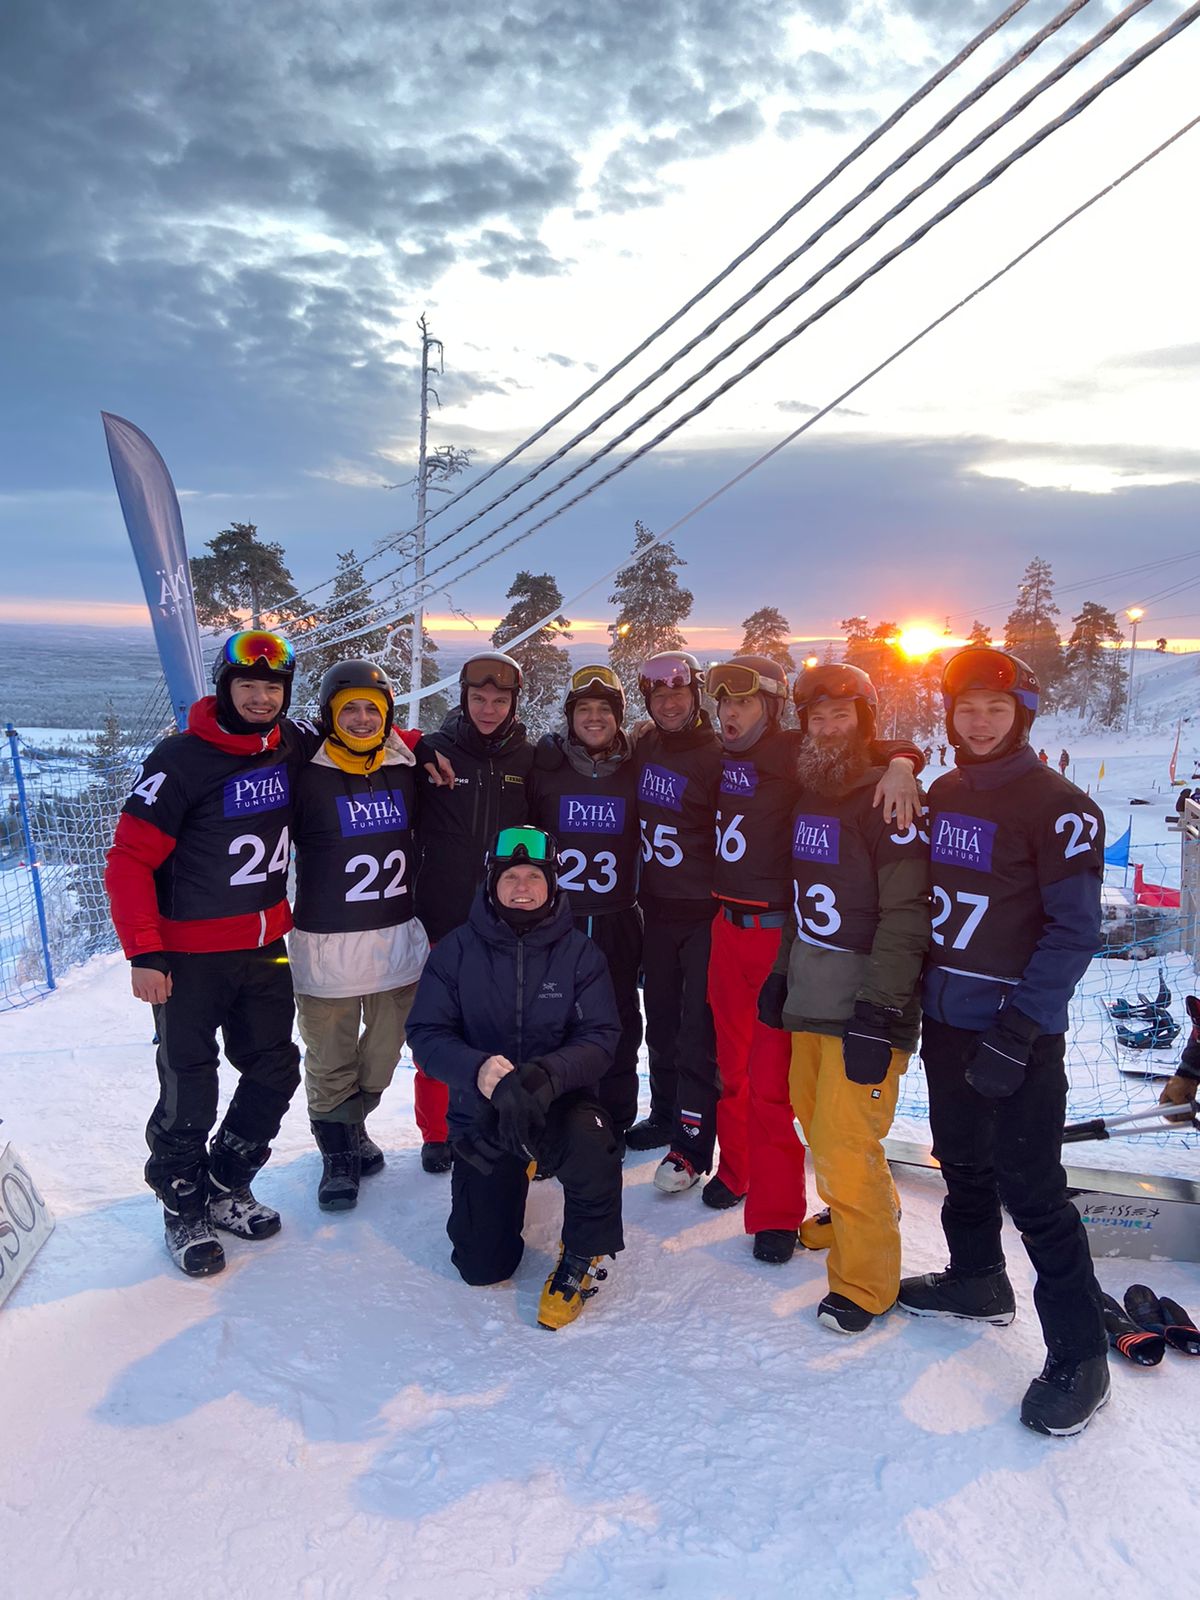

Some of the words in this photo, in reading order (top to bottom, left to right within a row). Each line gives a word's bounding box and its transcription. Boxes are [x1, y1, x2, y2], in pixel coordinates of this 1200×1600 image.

[234, 771, 285, 802] PYHÄ
[642, 768, 676, 798] PYHÄ
[642, 788, 676, 804] TUNTURI
[236, 793, 286, 809] TUNTURI
[568, 800, 617, 822] PYHÄ
[352, 818, 402, 830] TUNTURI
[567, 821, 617, 829] TUNTURI
[715, 809, 747, 863] 6
[795, 821, 830, 848] PYHÄ
[936, 820, 981, 854] PYHÄ
[1055, 812, 1099, 859] 27
[228, 825, 290, 886] 24
[935, 846, 980, 863] TUNTURI
[345, 849, 408, 902] 22
[557, 848, 618, 893] 23
[793, 879, 841, 936] 3
[931, 885, 990, 950] 27
